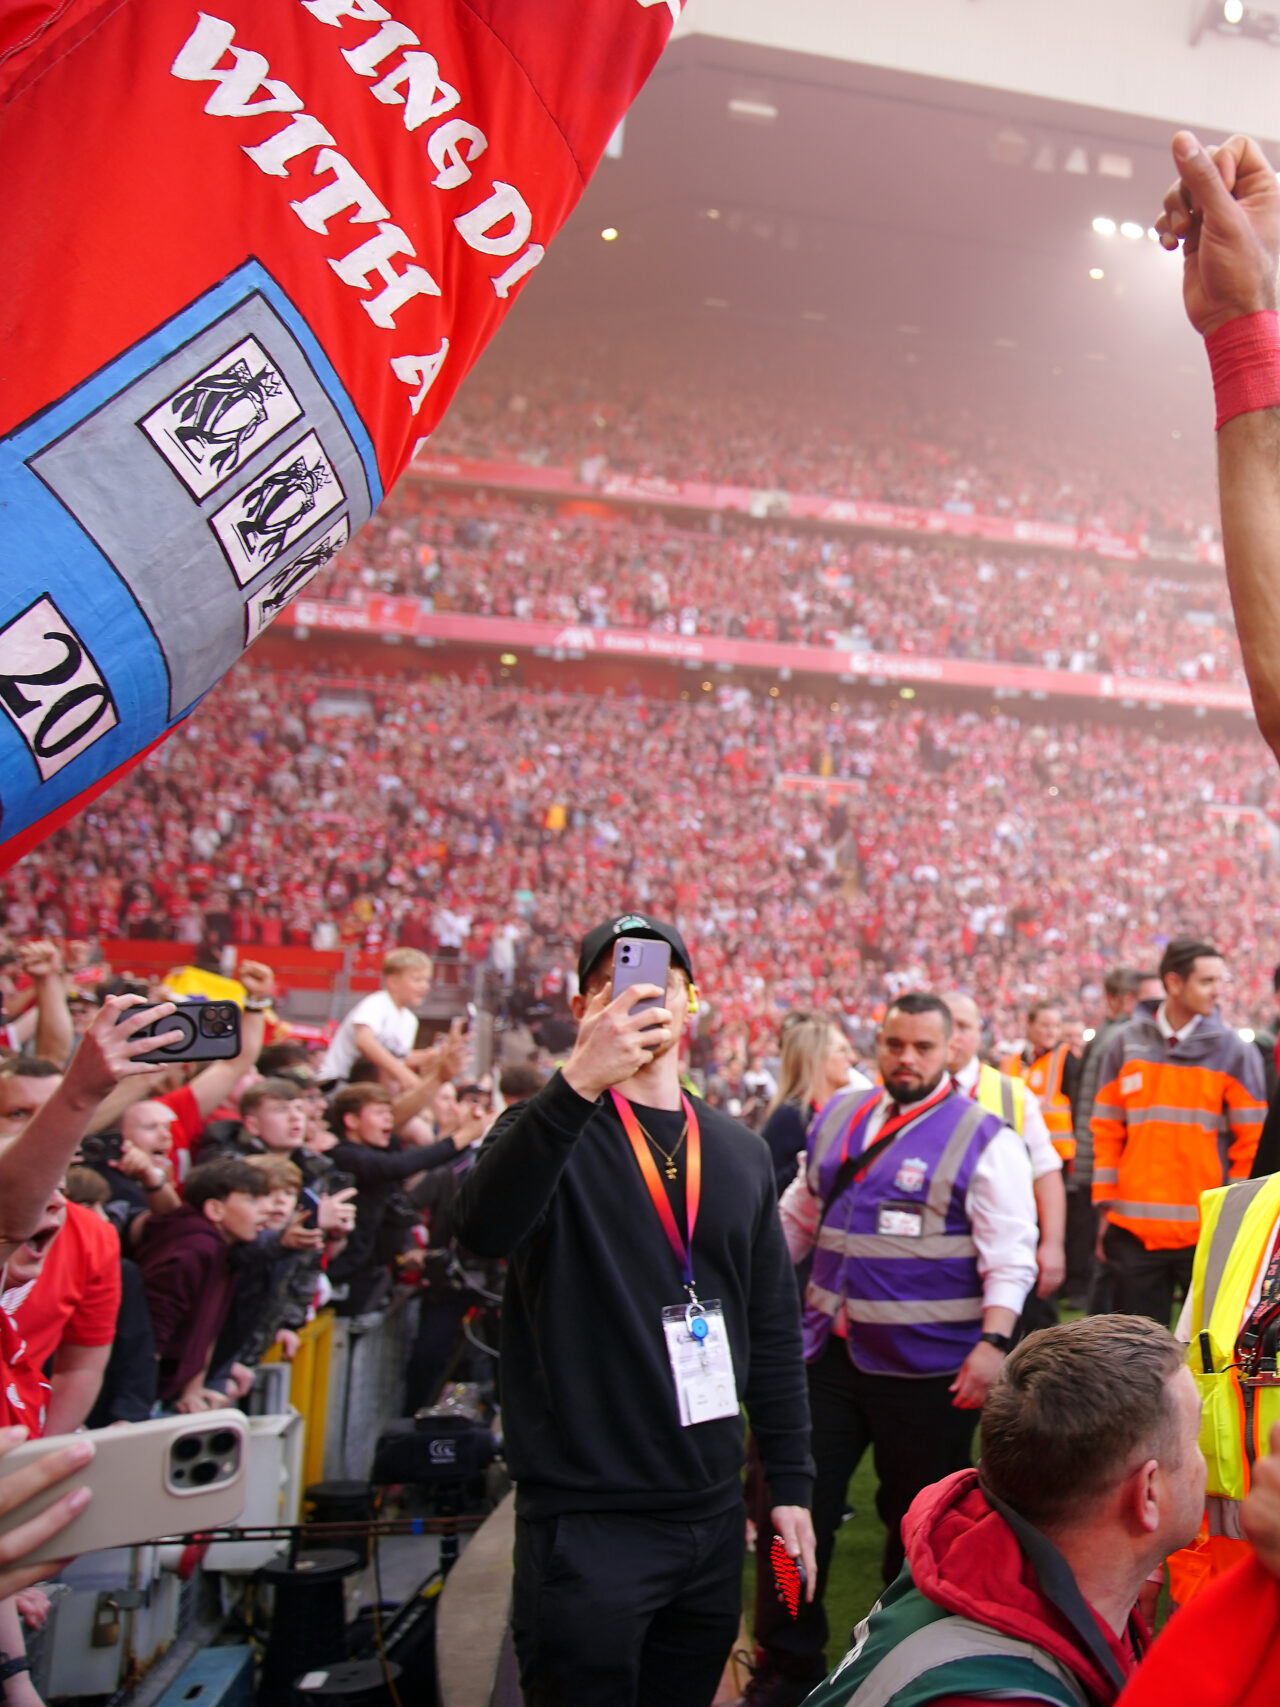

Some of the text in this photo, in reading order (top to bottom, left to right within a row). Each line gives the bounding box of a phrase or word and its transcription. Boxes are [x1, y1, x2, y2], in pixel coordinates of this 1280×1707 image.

[170, 12, 449, 416] WITH A
[0, 631, 109, 759] 20
